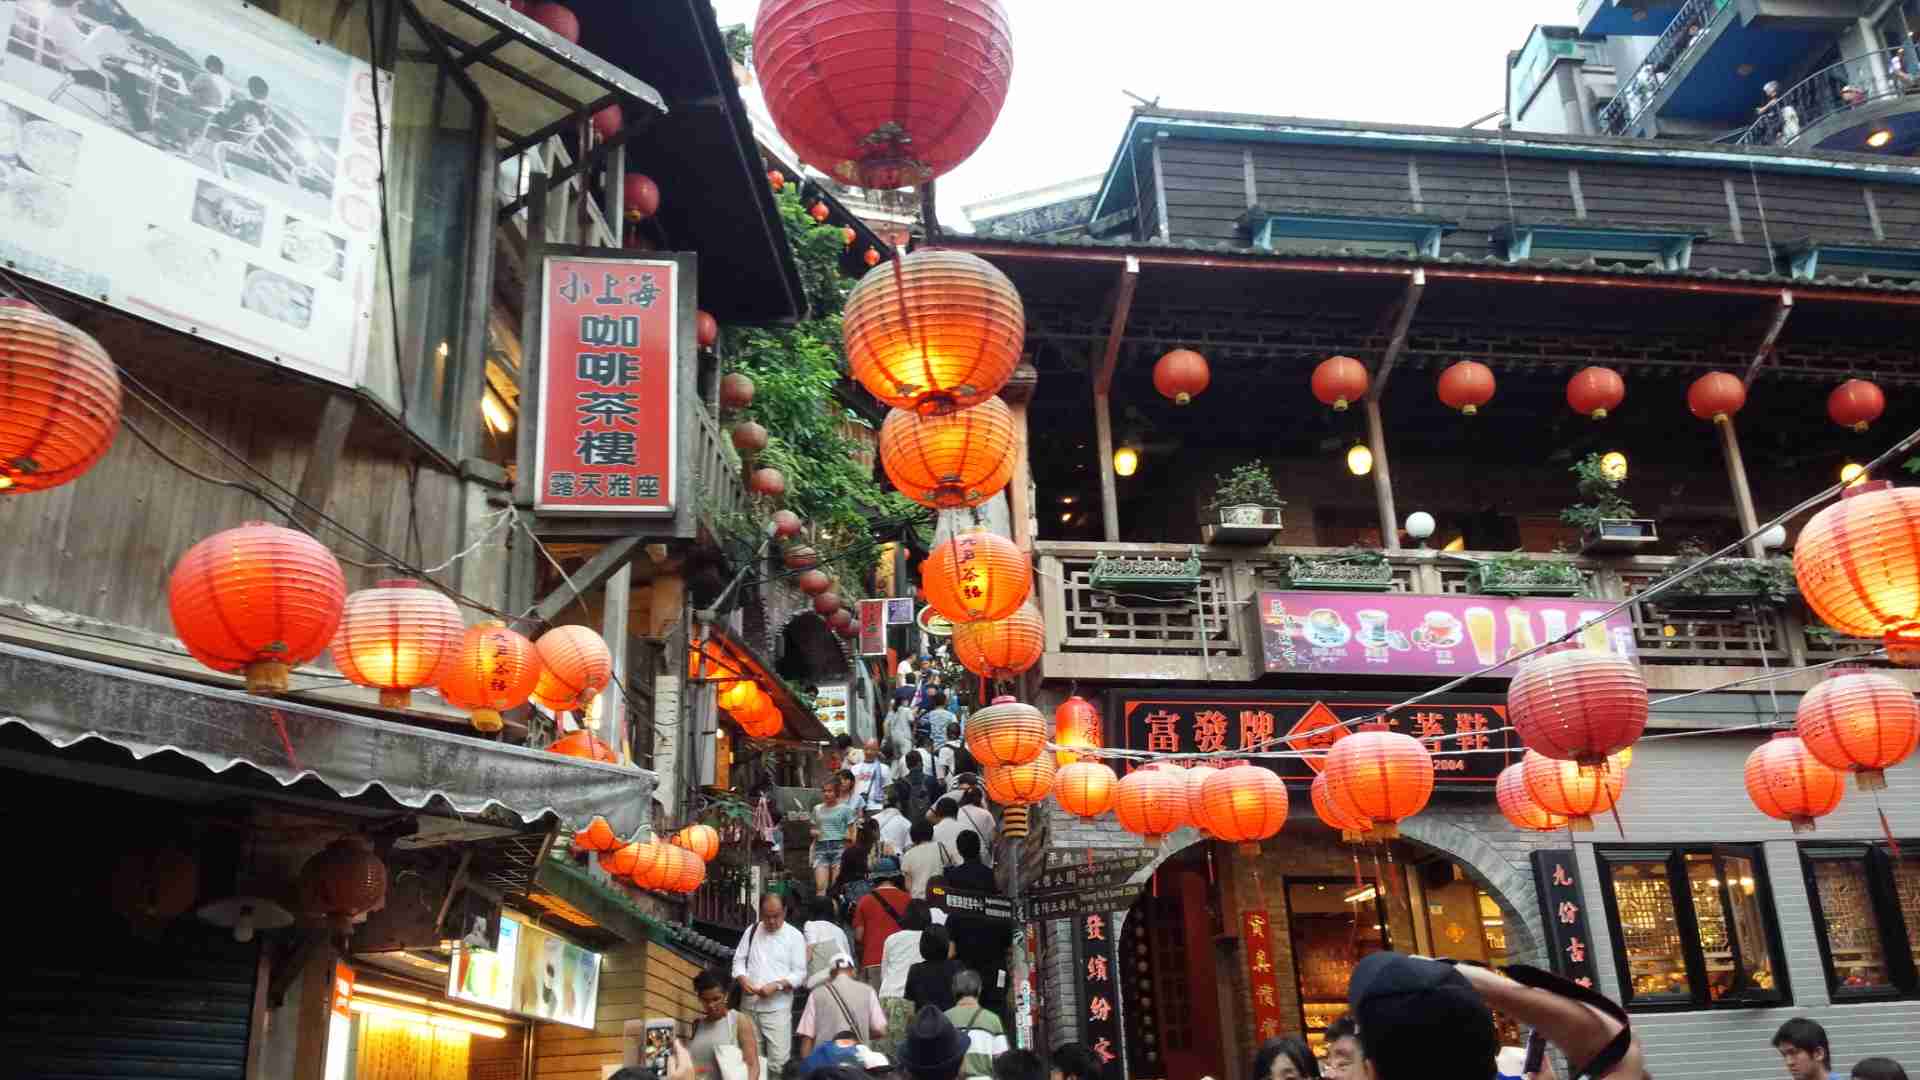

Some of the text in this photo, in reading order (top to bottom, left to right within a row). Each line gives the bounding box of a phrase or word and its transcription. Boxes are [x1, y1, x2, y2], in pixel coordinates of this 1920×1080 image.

[559, 272, 662, 307] 小上海
[577, 315, 640, 465] 咖啡茶樓
[550, 474, 659, 498] 露天雅座
[1144, 709, 1275, 753] 富發牌
